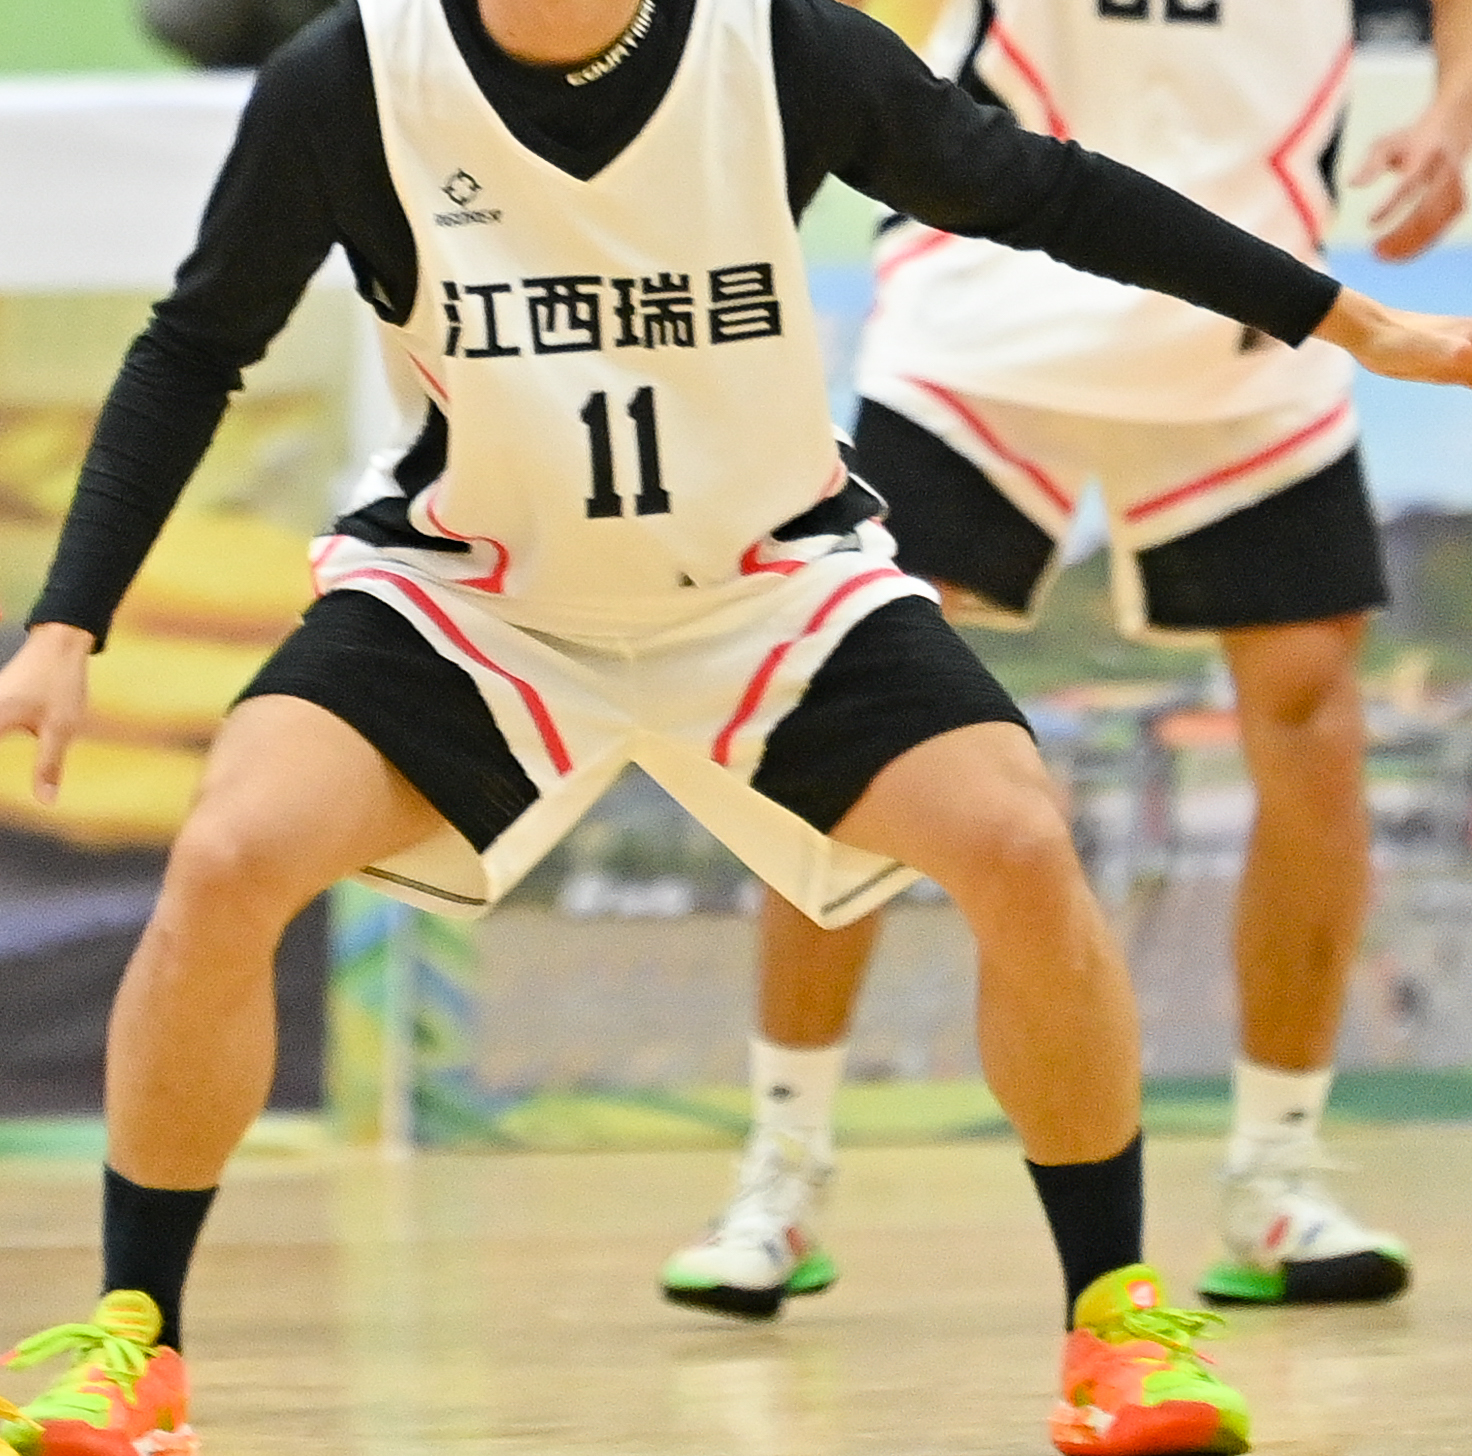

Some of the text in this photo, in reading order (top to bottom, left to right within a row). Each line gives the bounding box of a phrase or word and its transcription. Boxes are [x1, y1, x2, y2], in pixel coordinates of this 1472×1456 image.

[441, 262, 782, 359] 江西瑞昌
[579, 385, 672, 519] 11
